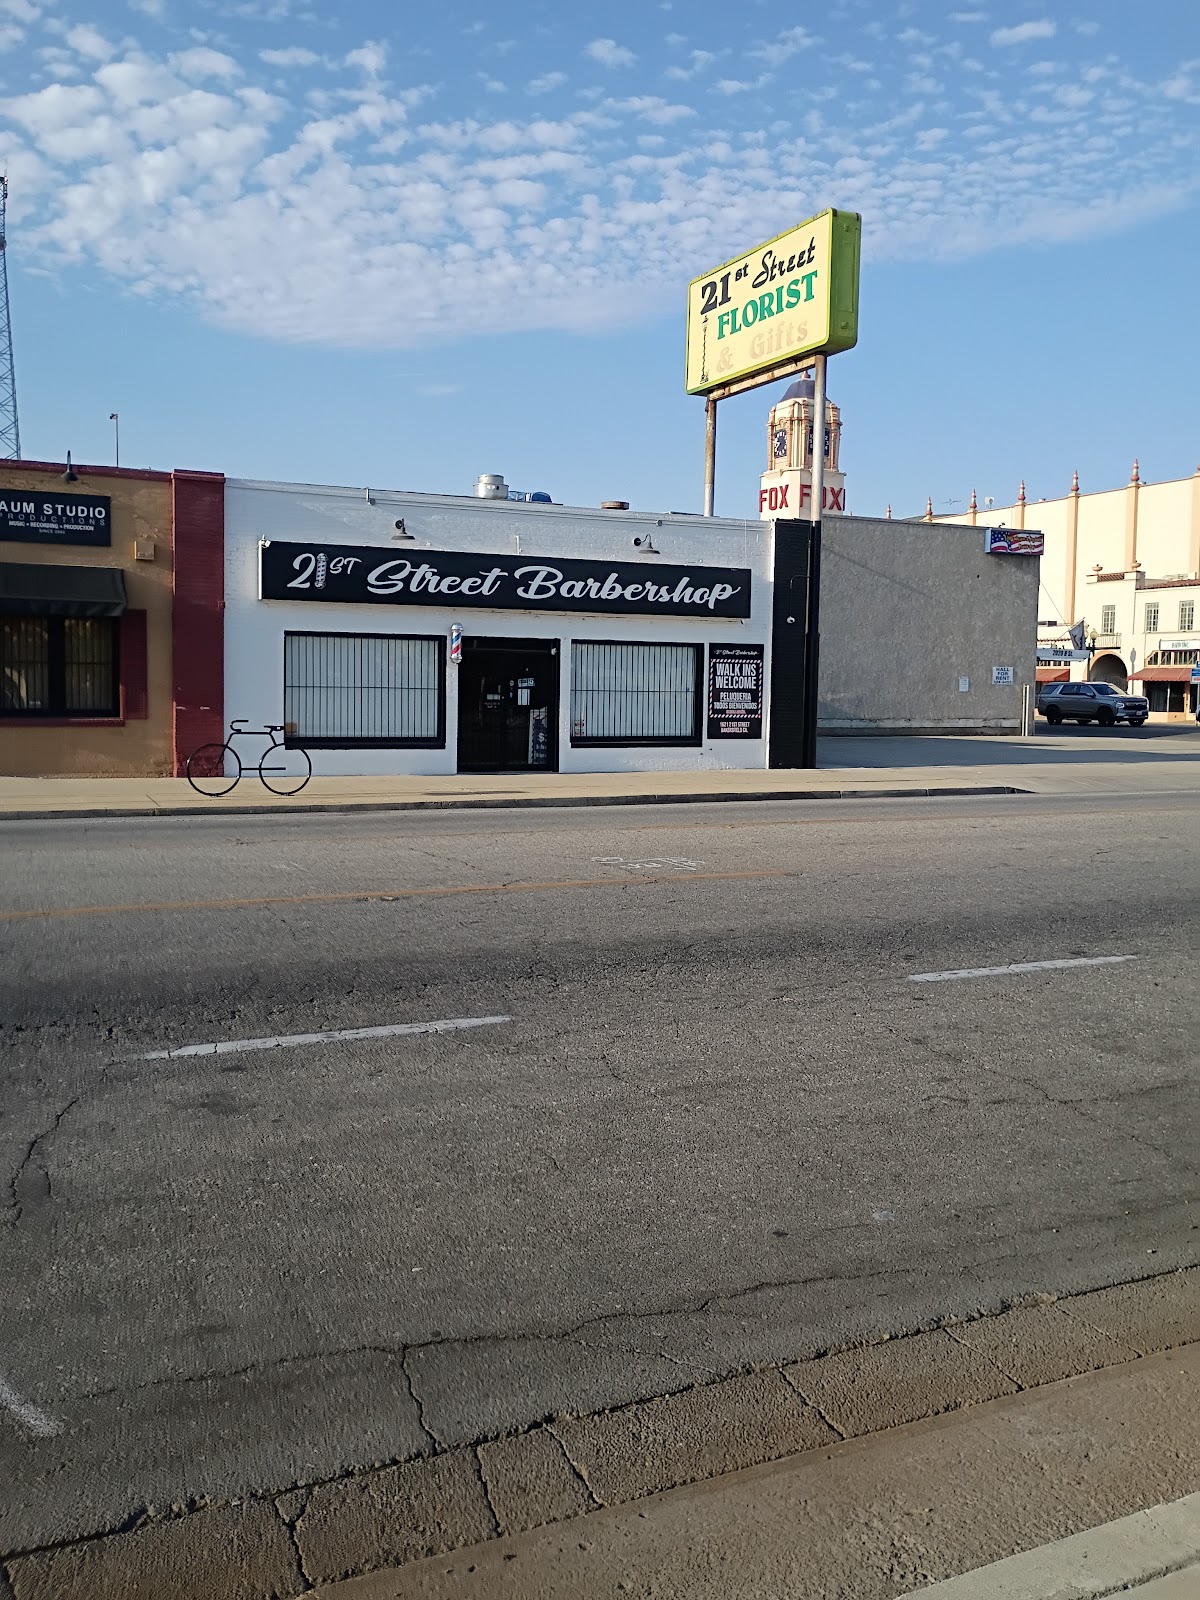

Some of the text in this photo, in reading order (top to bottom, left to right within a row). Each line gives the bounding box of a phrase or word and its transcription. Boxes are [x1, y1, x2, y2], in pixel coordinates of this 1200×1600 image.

[752, 237, 816, 289] Street
[717, 270, 818, 340] FLORIST
[716, 320, 808, 373] & Gifts
[0, 500, 106, 519] AUM STUDIO
[759, 484, 789, 512] FOX
[30, 522, 59, 530] RECORDING
[367, 559, 508, 596] Street
[514, 565, 741, 609] Barbershop
[715, 676, 757, 689] WELCOME
[716, 663, 756, 676] WALK INS
